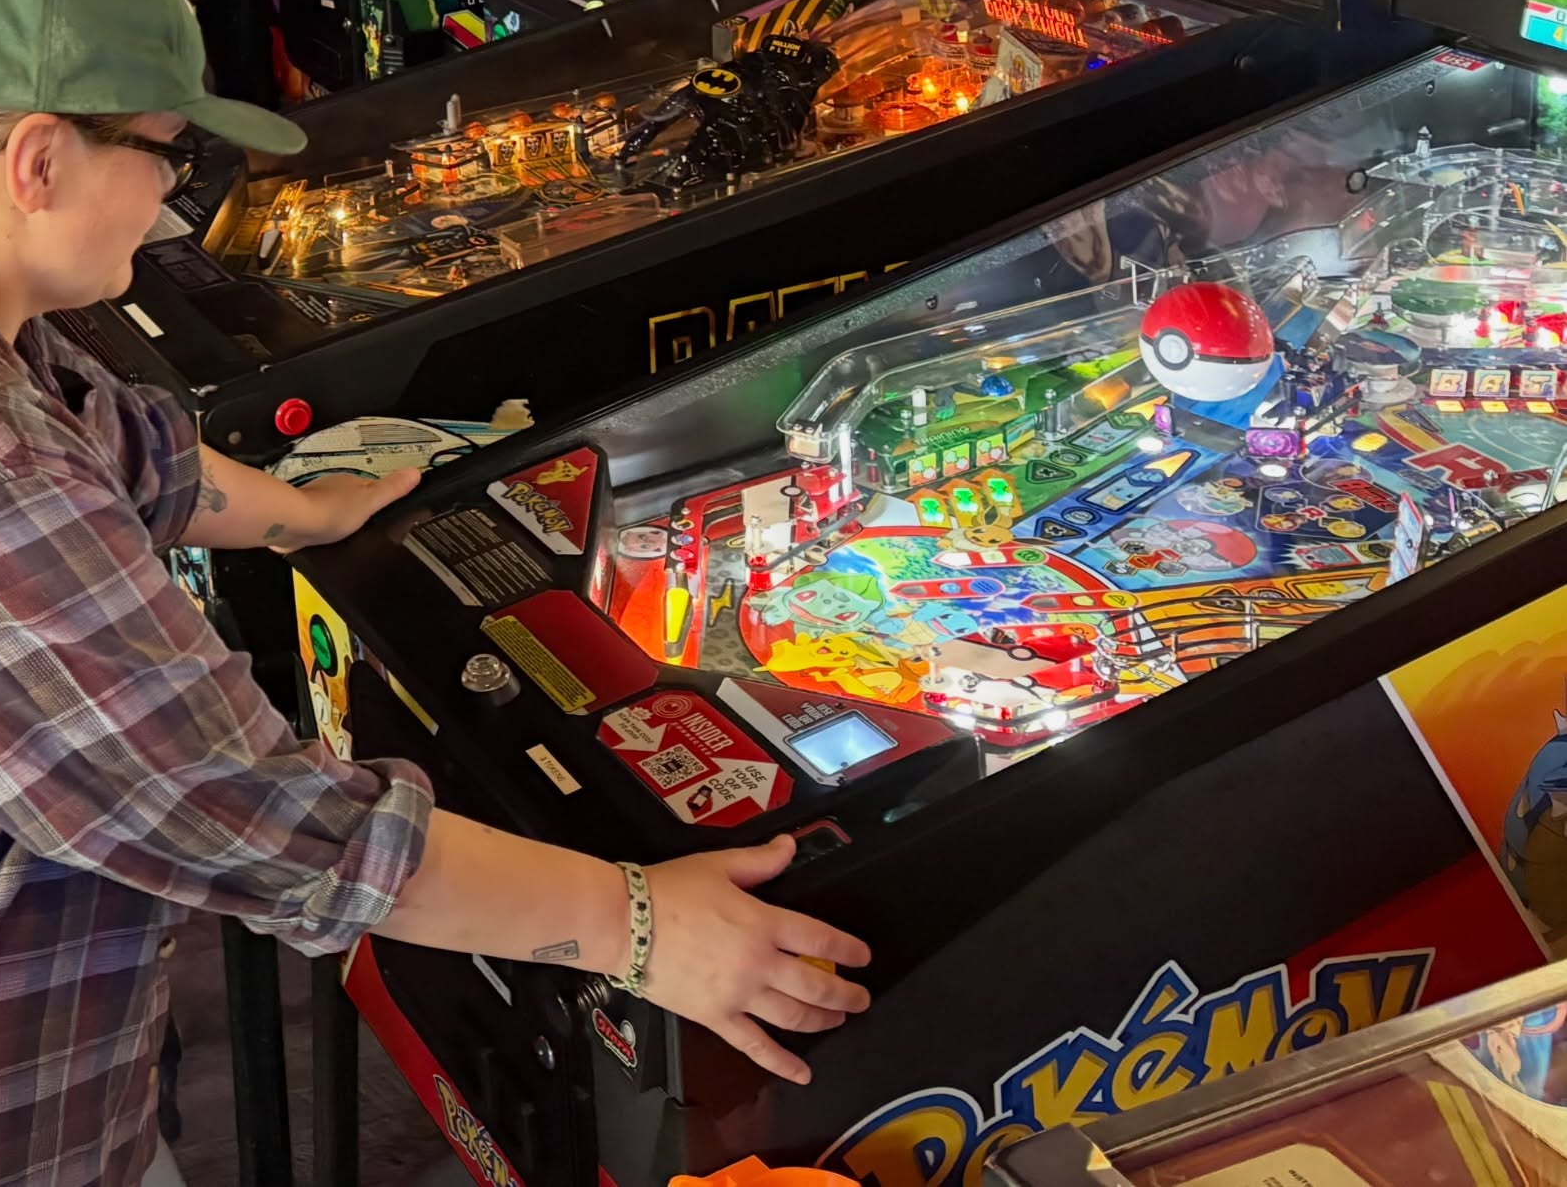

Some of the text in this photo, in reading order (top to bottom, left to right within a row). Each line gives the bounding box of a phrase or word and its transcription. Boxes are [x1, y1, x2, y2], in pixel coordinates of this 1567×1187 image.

[768, 44, 799, 57] PLUS
[1441, 55, 1474, 68] USA
[668, 721, 712, 756] CONNECTED
[680, 712, 734, 753] INSIDER
[724, 777, 742, 790] QR
[731, 768, 758, 790] YOUR
[744, 765, 768, 783] USE
[708, 778, 736, 801] CODE
